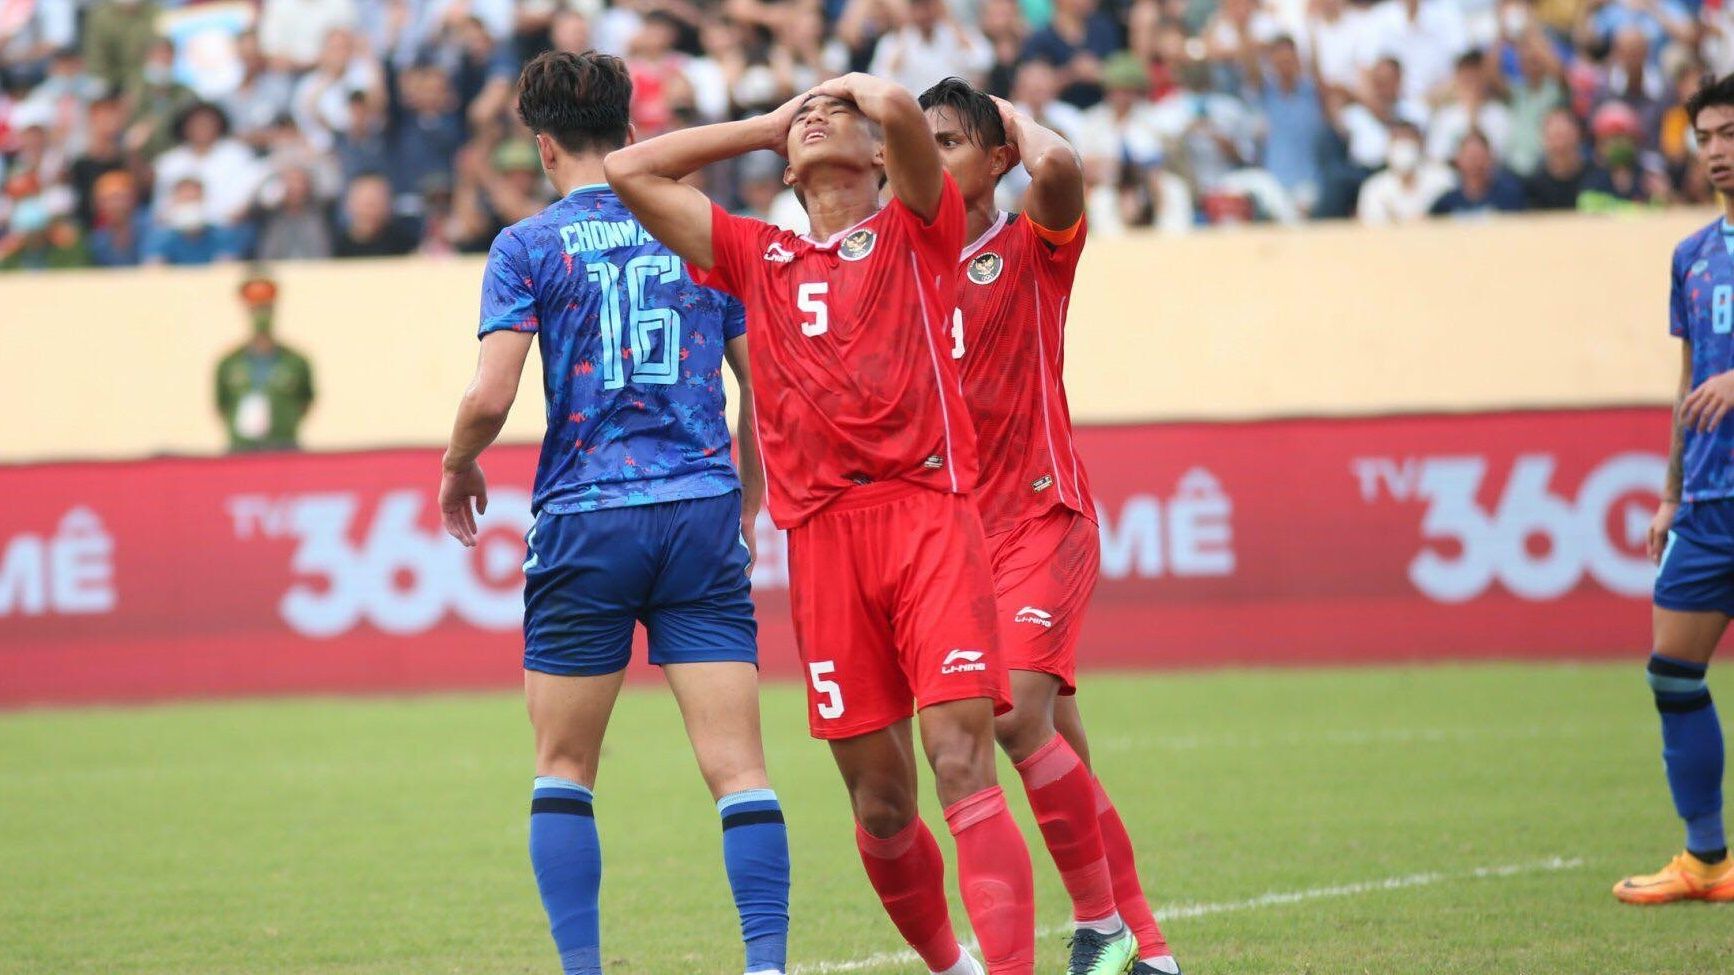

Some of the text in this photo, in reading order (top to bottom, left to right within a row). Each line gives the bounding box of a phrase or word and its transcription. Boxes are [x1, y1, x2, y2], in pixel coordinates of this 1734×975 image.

[586, 255, 681, 390] 16
[797, 282, 829, 337] 5
[1712, 284, 1733, 334] 8
[809, 660, 845, 719] 5
[941, 663, 985, 673] LI-NING
